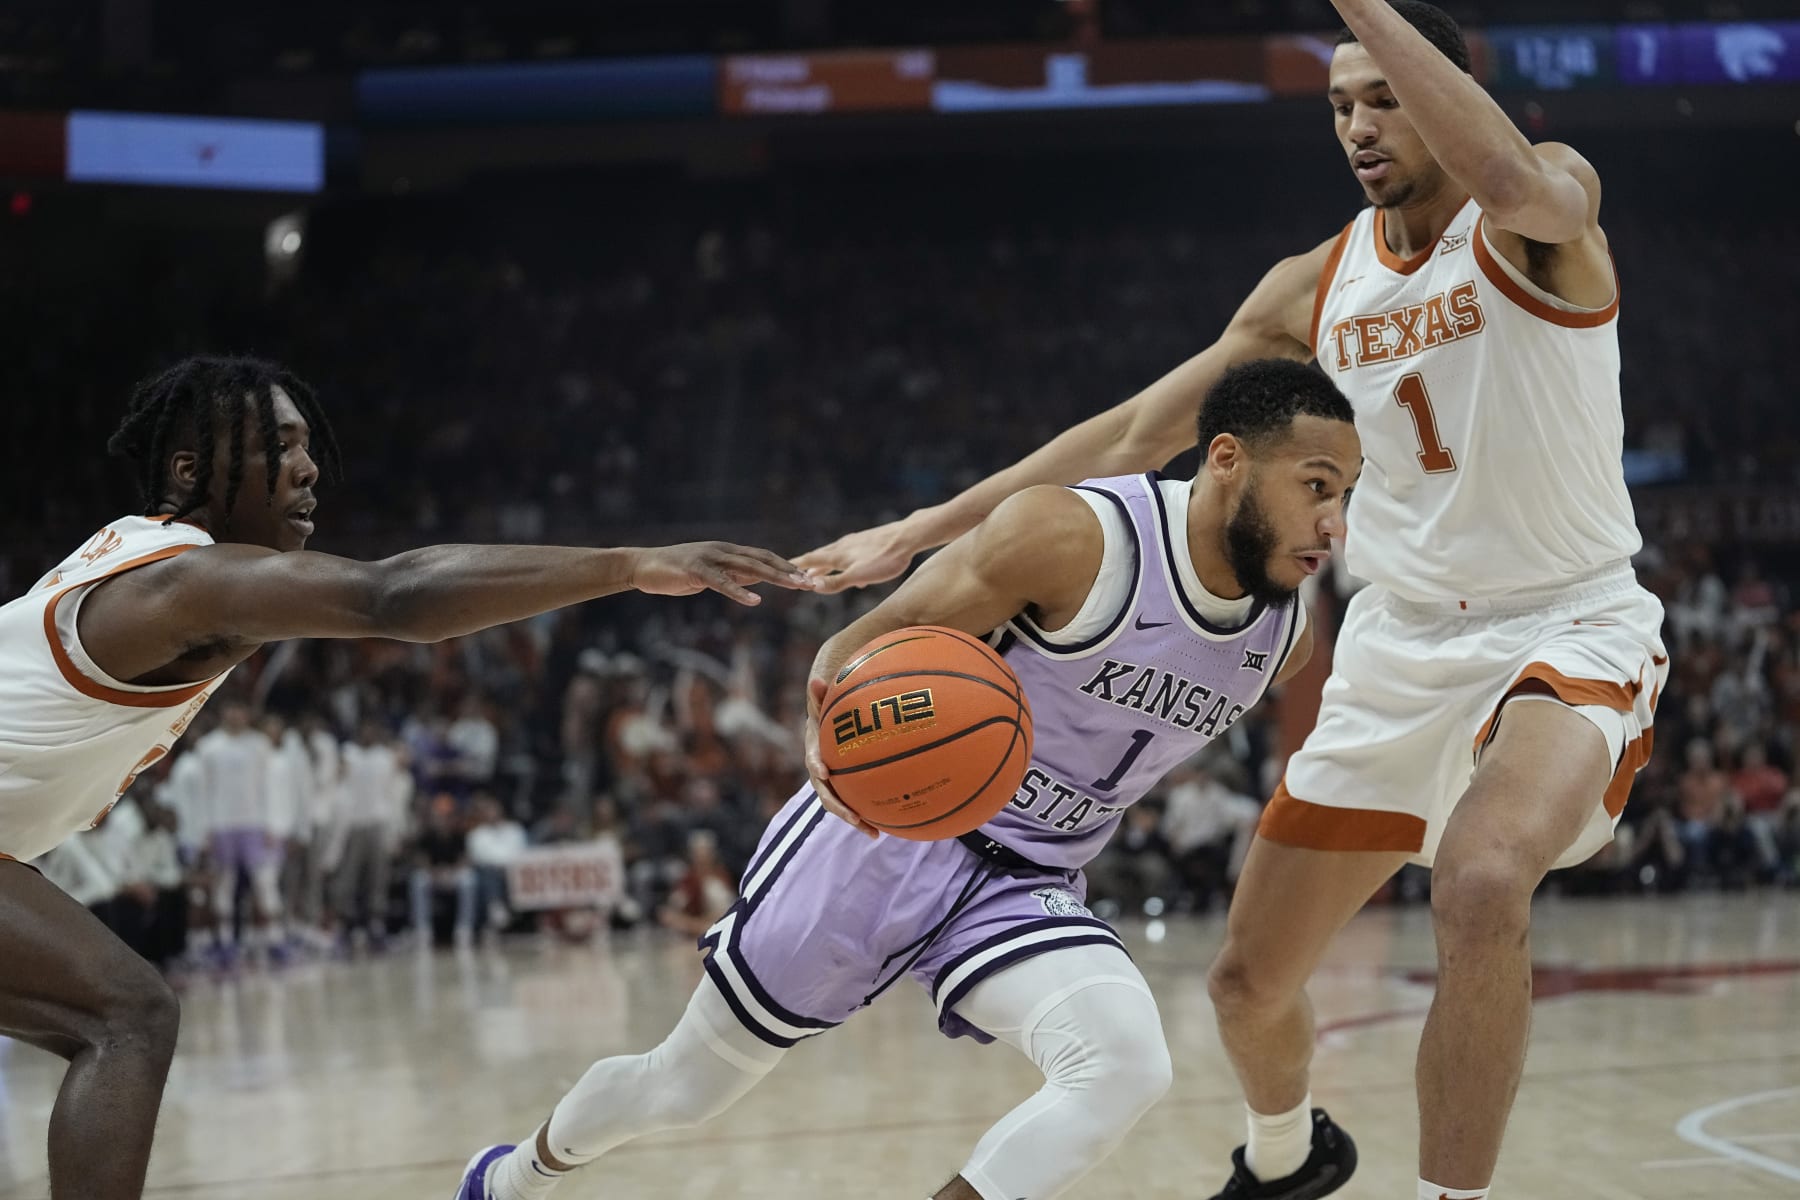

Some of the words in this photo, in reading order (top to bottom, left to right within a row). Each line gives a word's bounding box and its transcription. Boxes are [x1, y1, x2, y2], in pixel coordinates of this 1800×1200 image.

[1329, 280, 1486, 372] TEXAS
[1393, 372, 1456, 474] 1
[832, 688, 935, 745] ELITE
[1089, 728, 1156, 792] 1
[1009, 767, 1127, 832] STA
